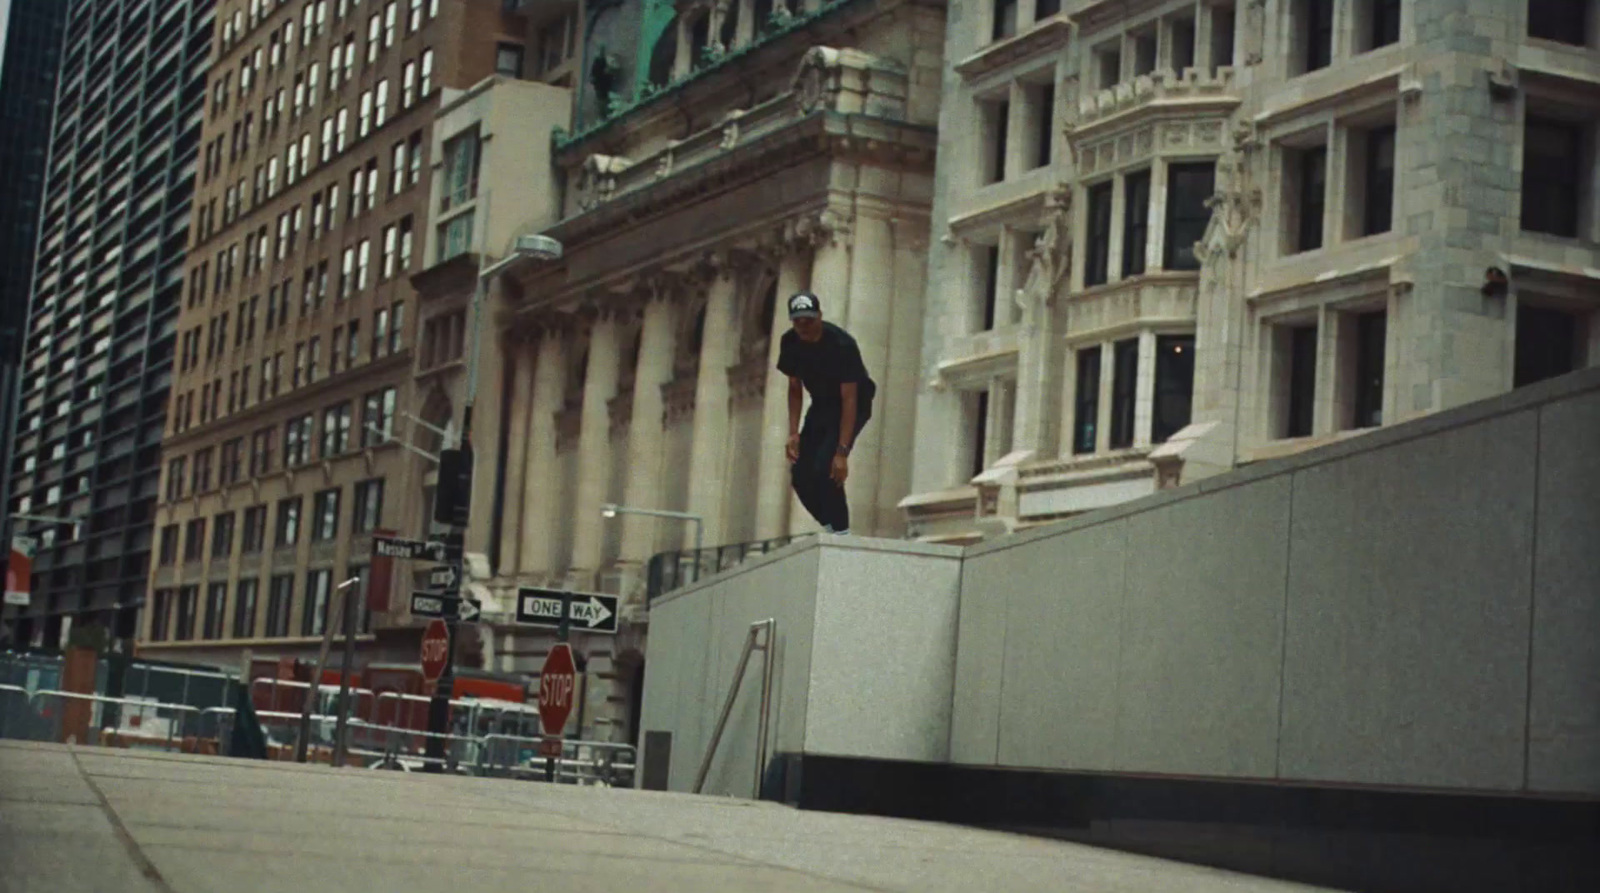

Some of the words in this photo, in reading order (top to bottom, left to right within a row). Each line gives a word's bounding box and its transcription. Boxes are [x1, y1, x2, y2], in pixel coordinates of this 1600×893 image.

[531, 600, 560, 615] ONE
[573, 604, 602, 618] WAY
[422, 639, 447, 661] STOP
[541, 673, 573, 707] STOP
